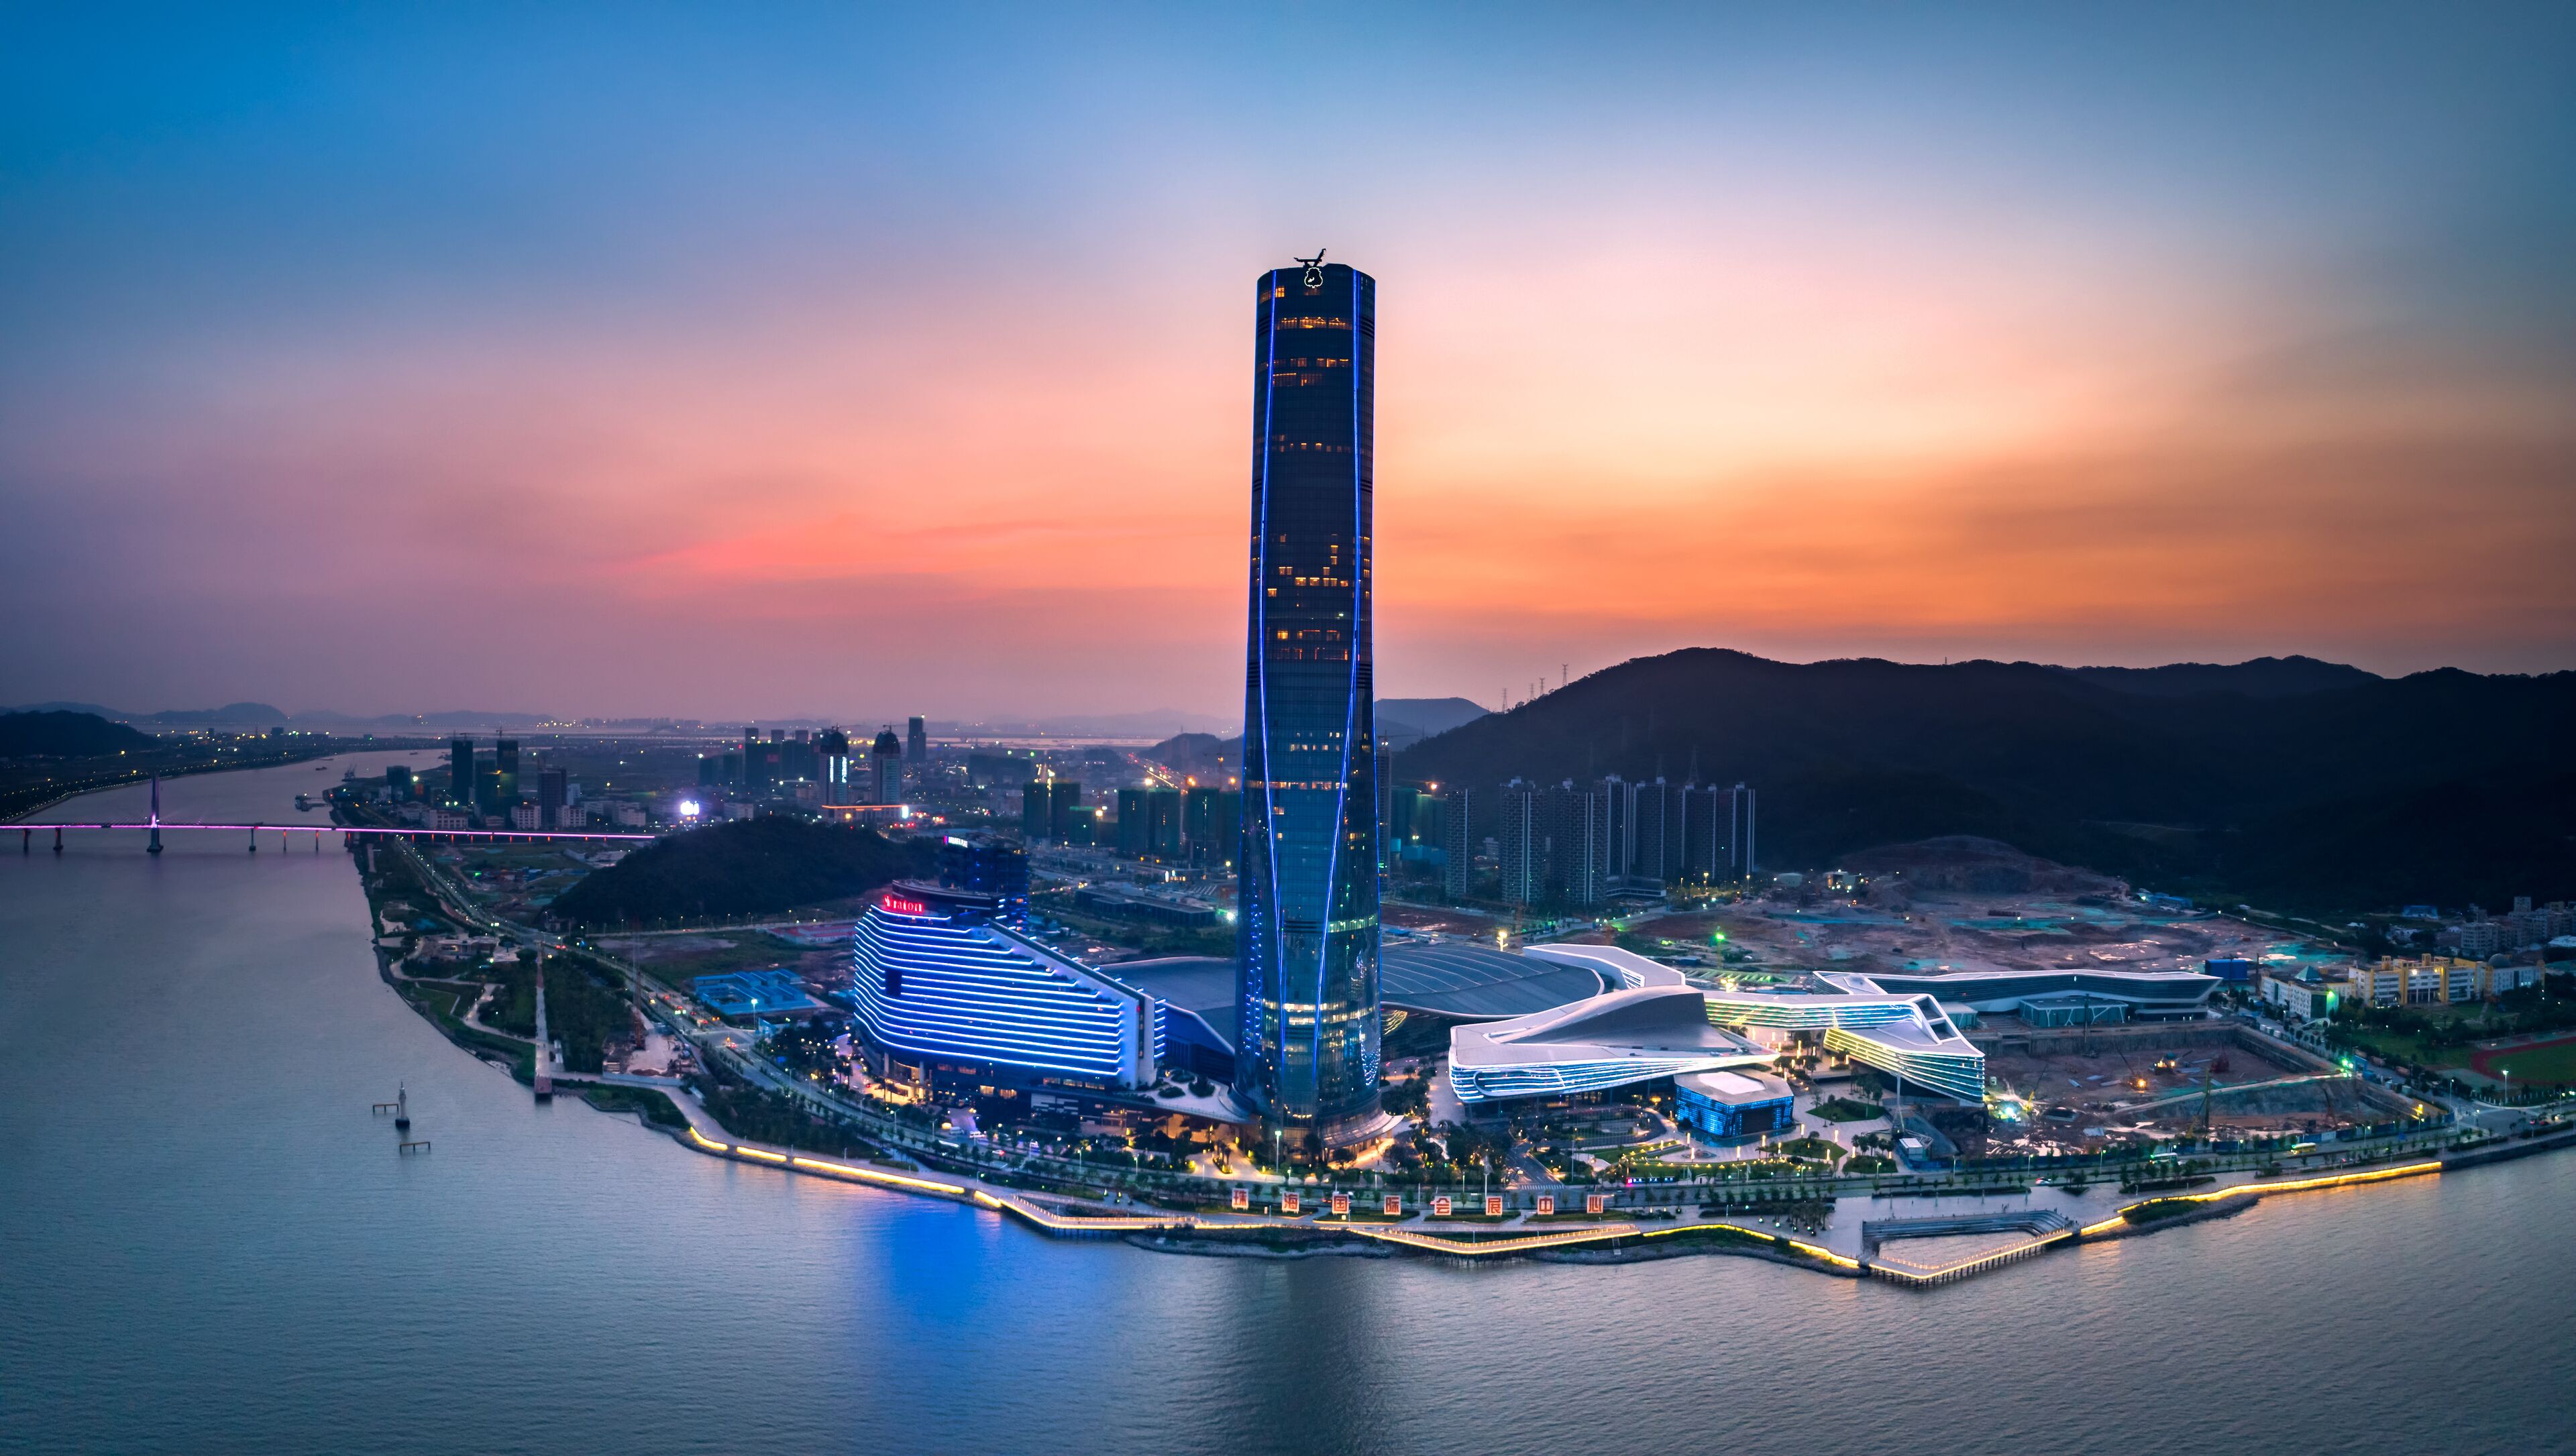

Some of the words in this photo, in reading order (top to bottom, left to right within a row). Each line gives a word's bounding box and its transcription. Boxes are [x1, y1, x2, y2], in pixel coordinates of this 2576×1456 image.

[1233, 1189, 1602, 1214] 珠海国际会展中心
